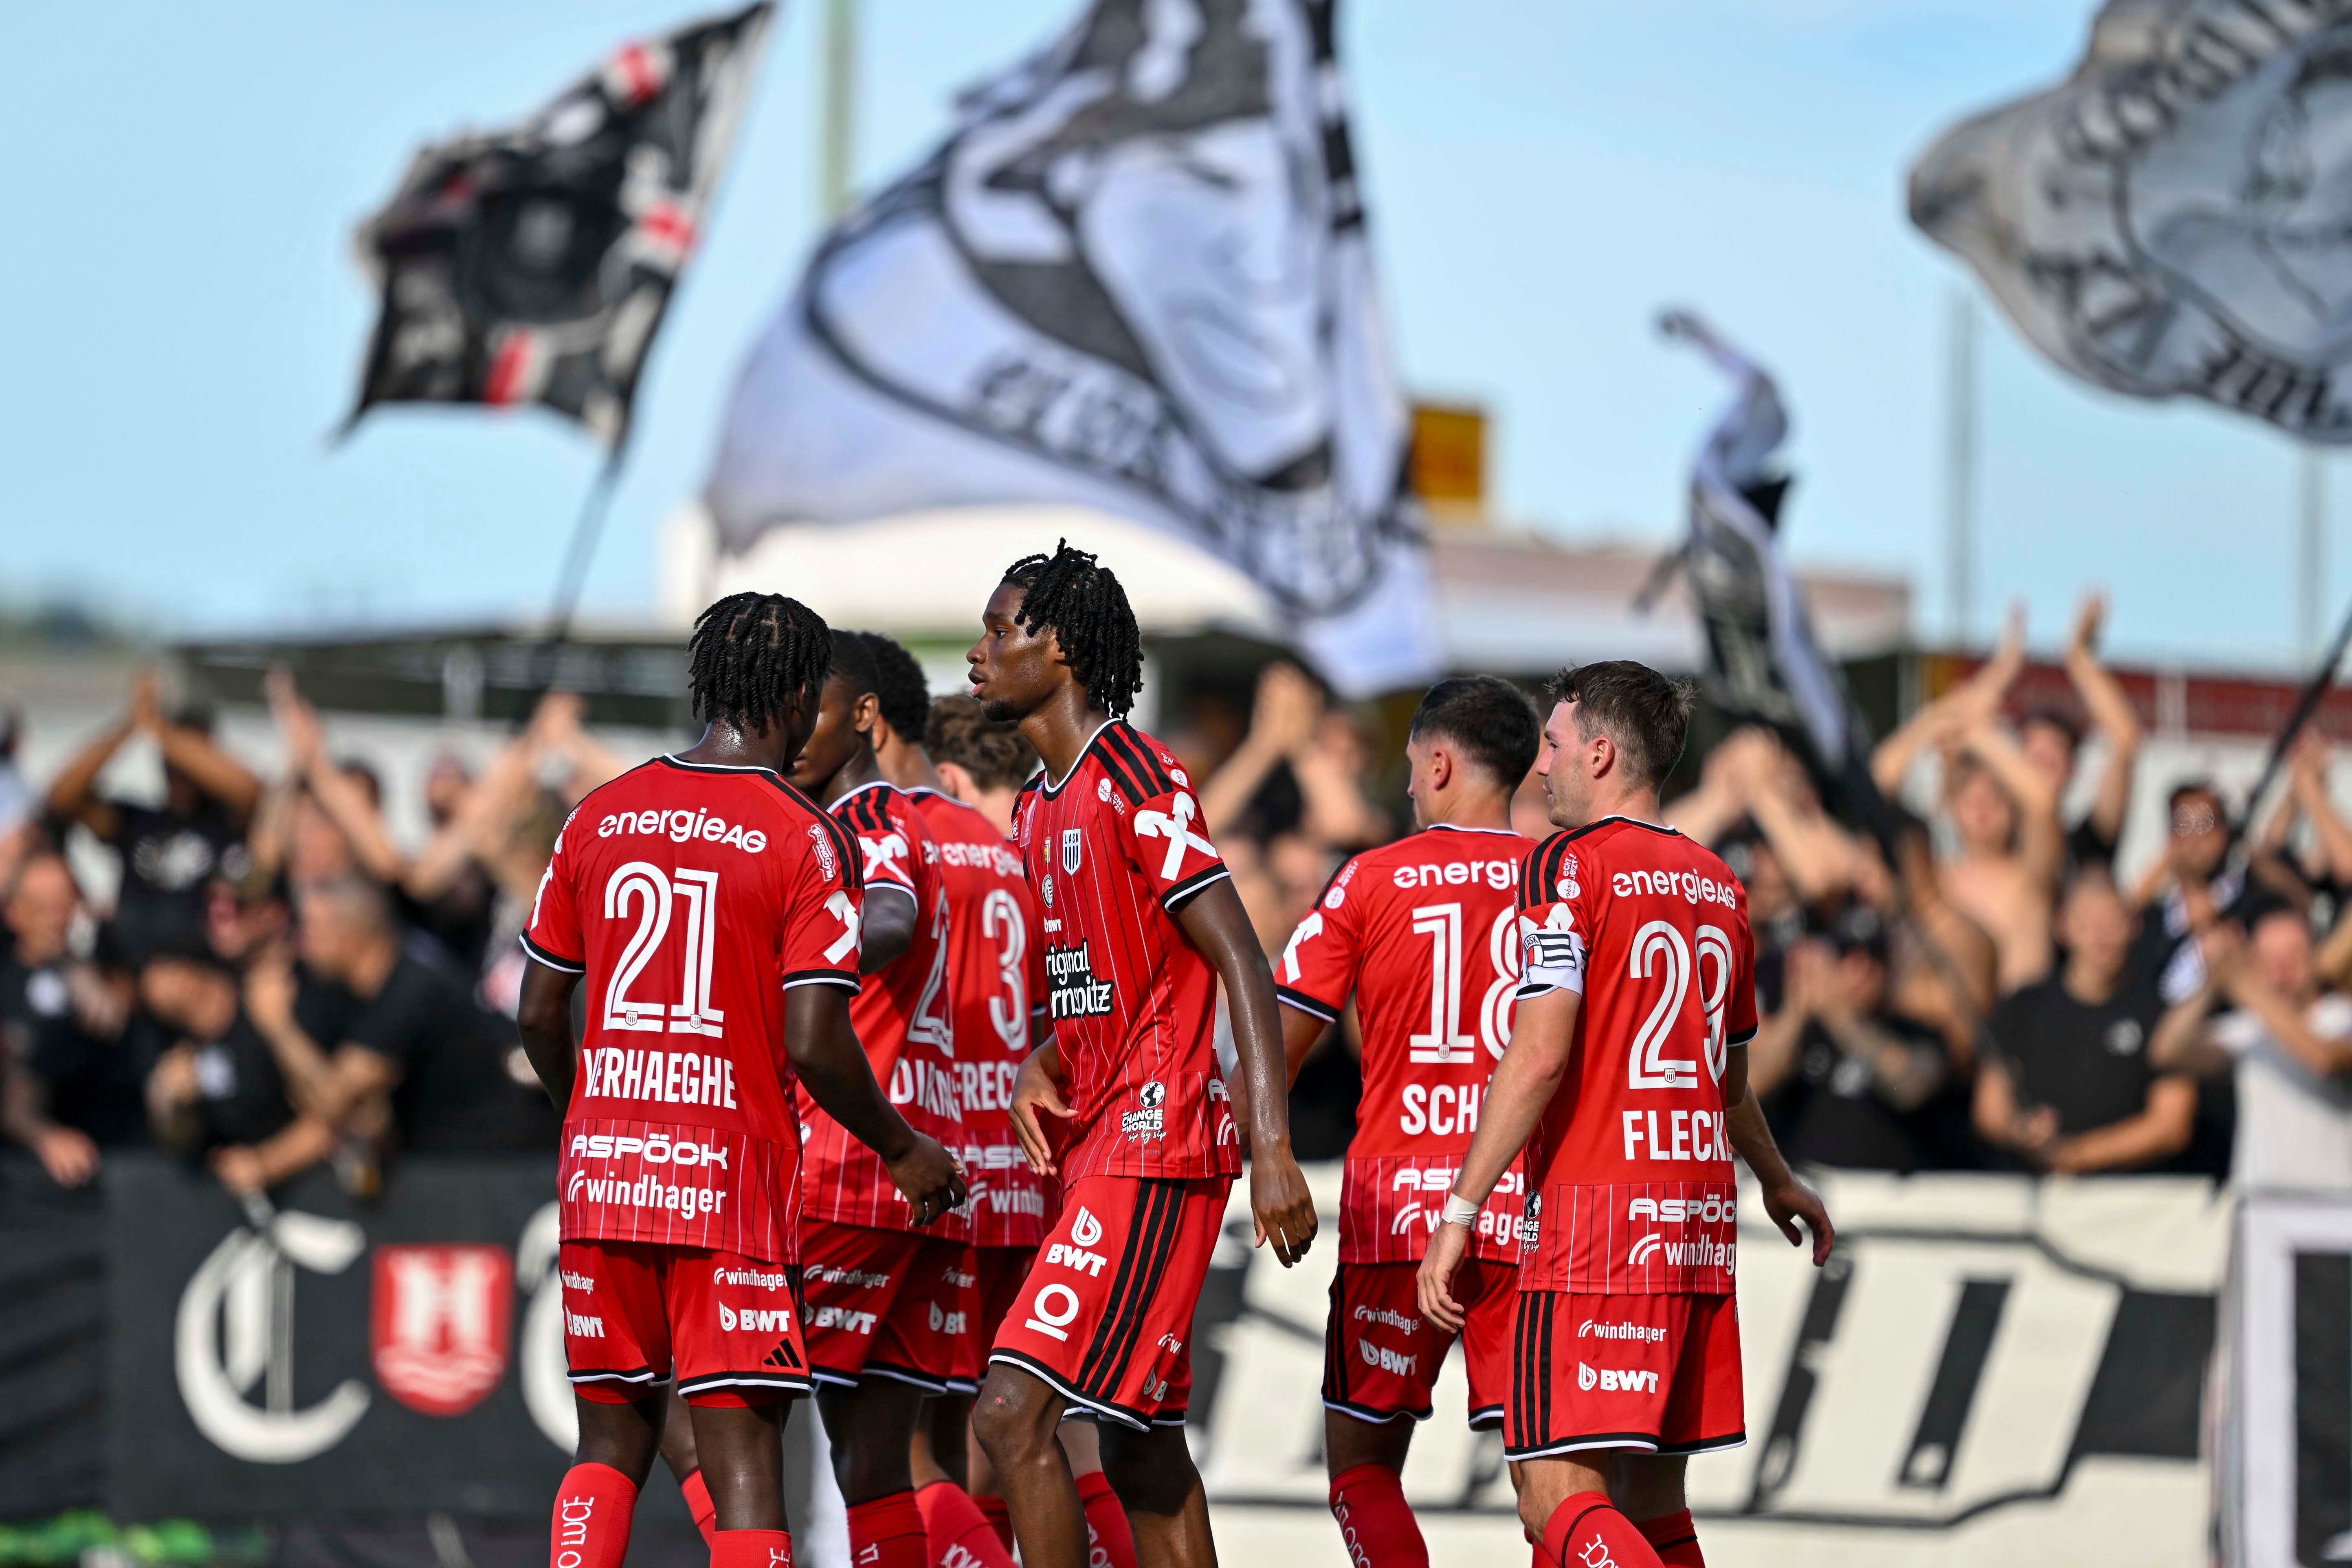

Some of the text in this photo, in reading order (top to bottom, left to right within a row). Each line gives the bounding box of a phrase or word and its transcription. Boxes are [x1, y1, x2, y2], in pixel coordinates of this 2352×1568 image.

[1065, 833, 1079, 844] LASK
[1393, 858, 1519, 890] energi
[1048, 919, 1062, 932] BWT
[603, 861, 724, 1039] 21
[1525, 936, 1539, 948] LASK
[982, 889, 1026, 1051] 3
[1046, 941, 1090, 985] riginal
[1410, 903, 1519, 1064] 18
[1629, 920, 1732, 1089] 29
[583, 1047, 737, 1110] VERHAEGHE
[1122, 1109, 1163, 1127] CHANGE
[1400, 1074, 1493, 1136] SCH
[1126, 1120, 1163, 1134] WORLD
[1128, 1133, 1139, 1144] sip
[1153, 1130, 1167, 1142] sip
[570, 1133, 728, 1170] ASPÖCK
[587, 1171, 726, 1220] windhager
[1629, 1194, 1737, 1223] ASPÖC
[1045, 1243, 1107, 1278] BWT
[1664, 1233, 1736, 1275] windhag
[572, 1314, 605, 1338] BWT
[740, 1309, 790, 1332] BWT
[816, 1306, 877, 1335] BWT
[1594, 1321, 1667, 1344] windhager
[1380, 1346, 1418, 1376] BWT
[1600, 1369, 1659, 1394] BWT
[561, 1496, 595, 1546] LUCE
